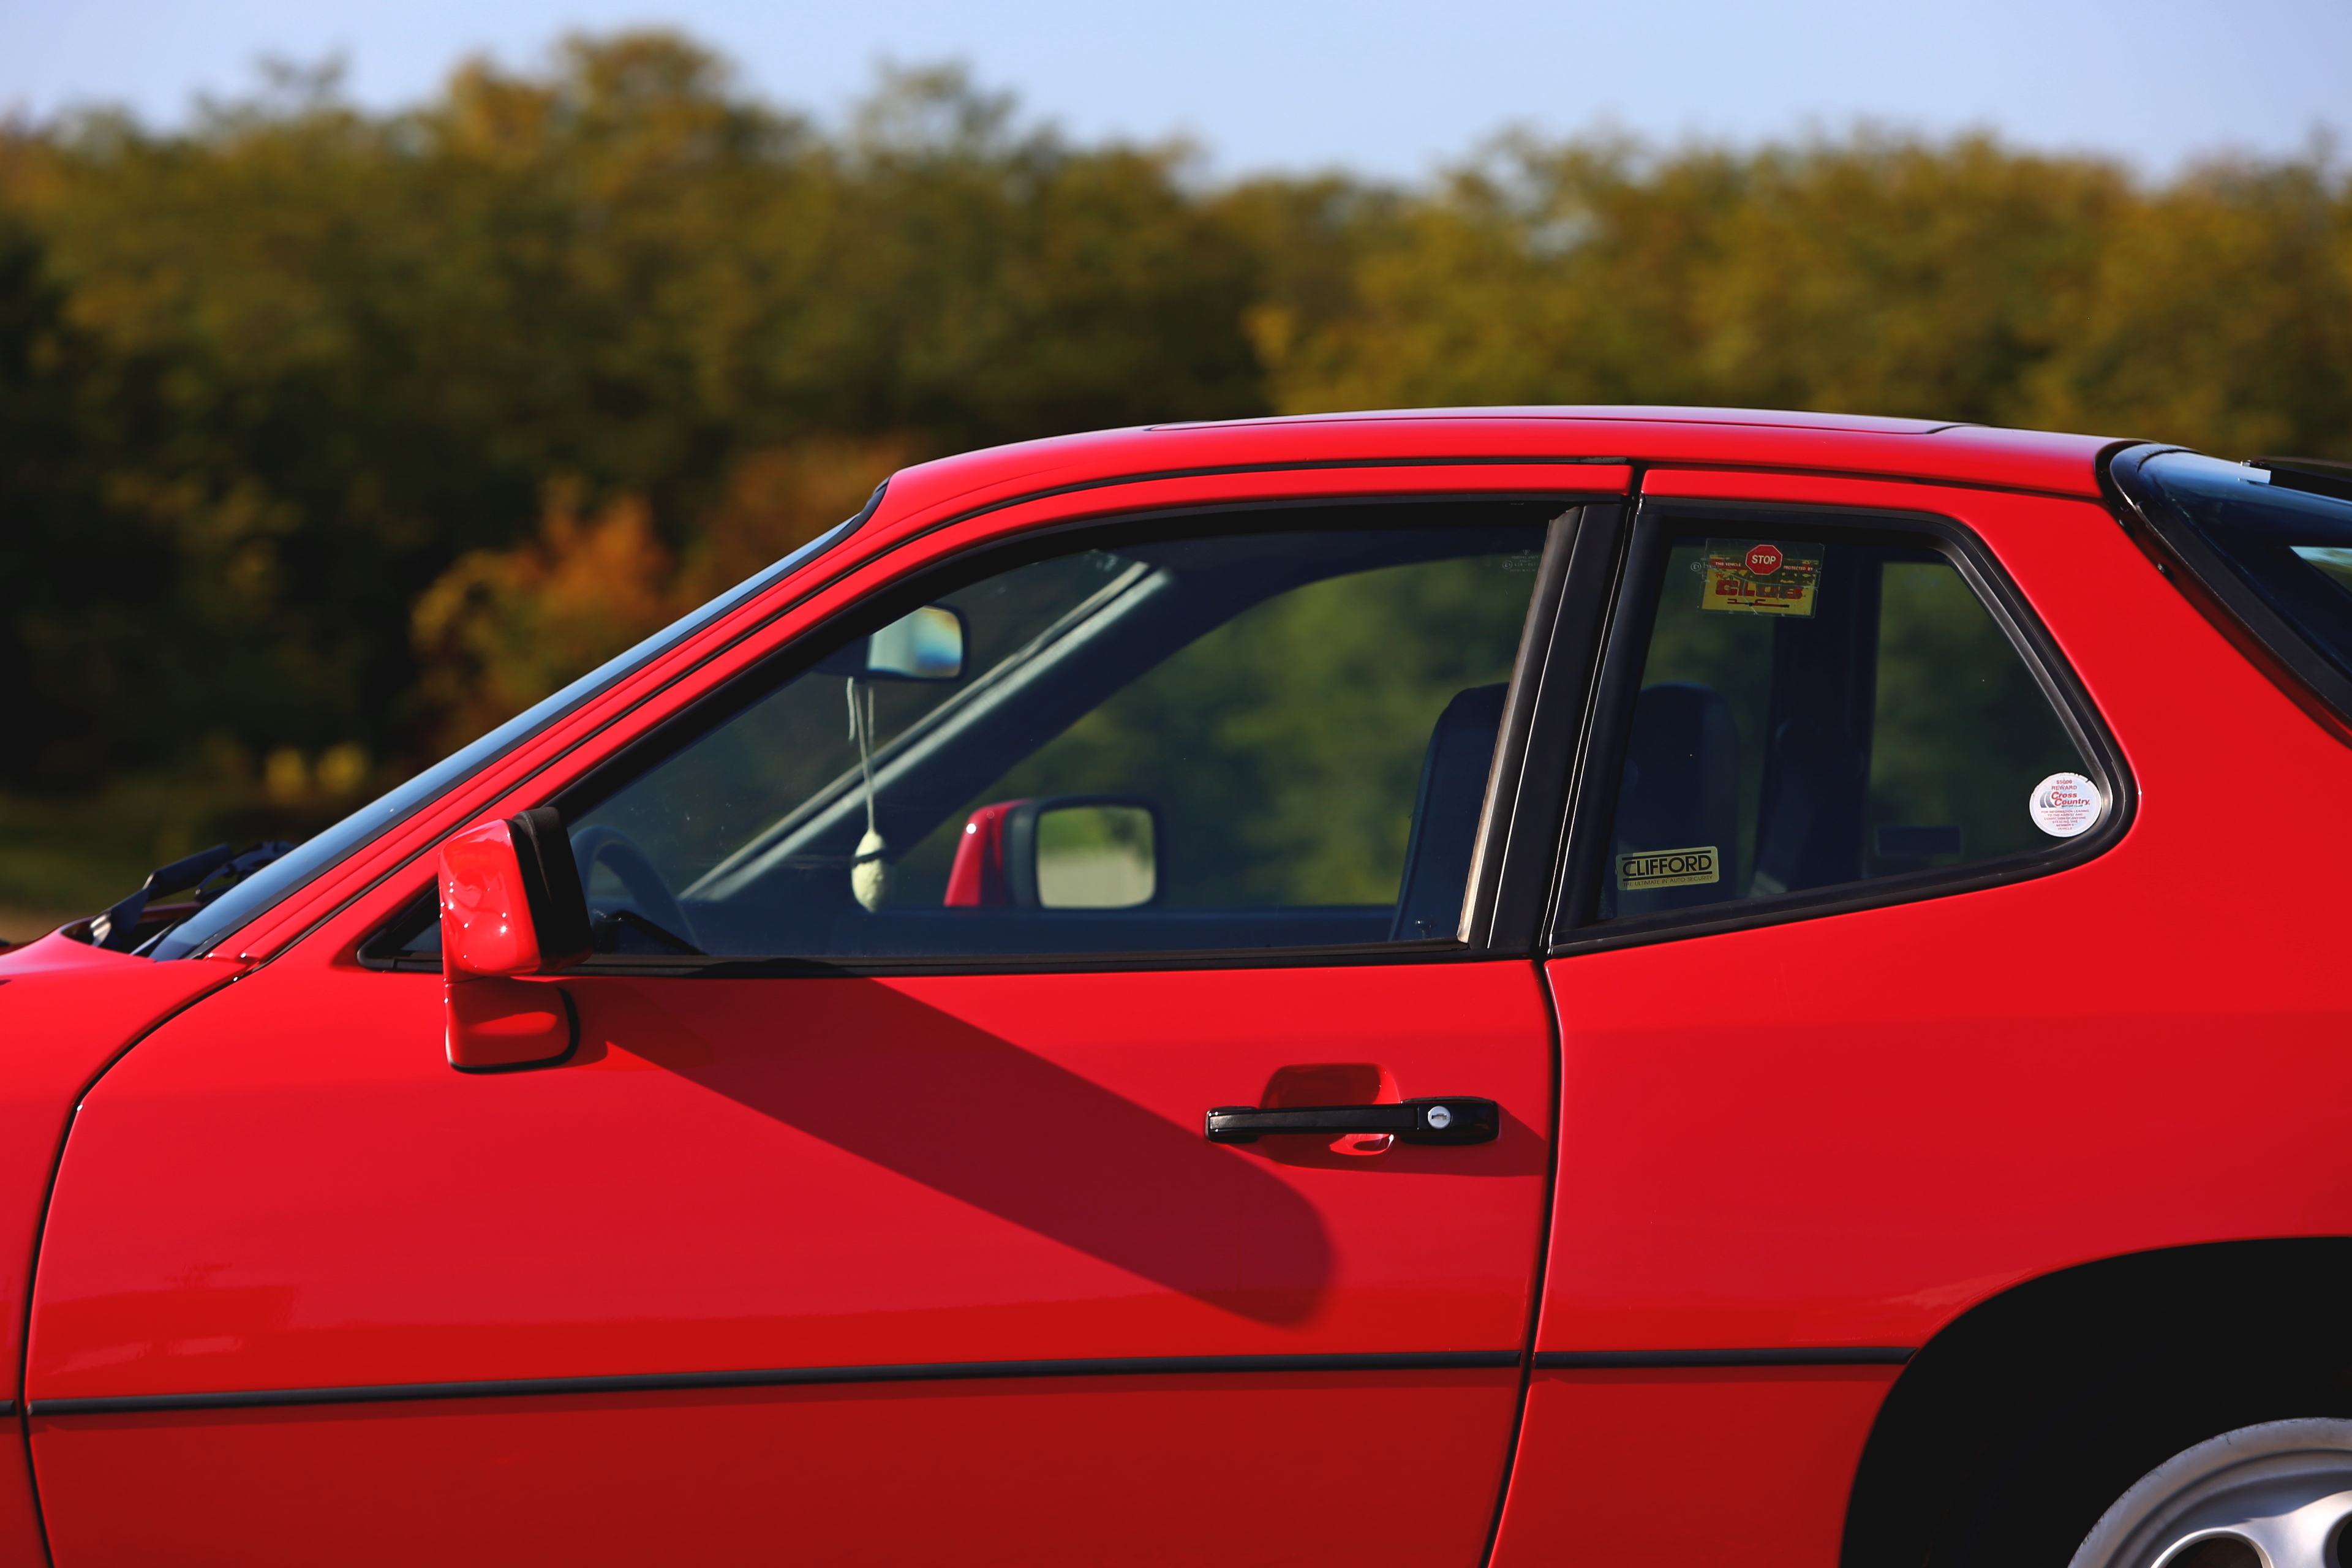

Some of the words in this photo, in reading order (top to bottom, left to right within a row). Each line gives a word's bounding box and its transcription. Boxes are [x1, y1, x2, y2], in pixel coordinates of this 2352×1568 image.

[1752, 555, 1776, 565] STOP
[2051, 791, 2078, 800] Cross
[1623, 854, 1712, 876] CLIFFORD
